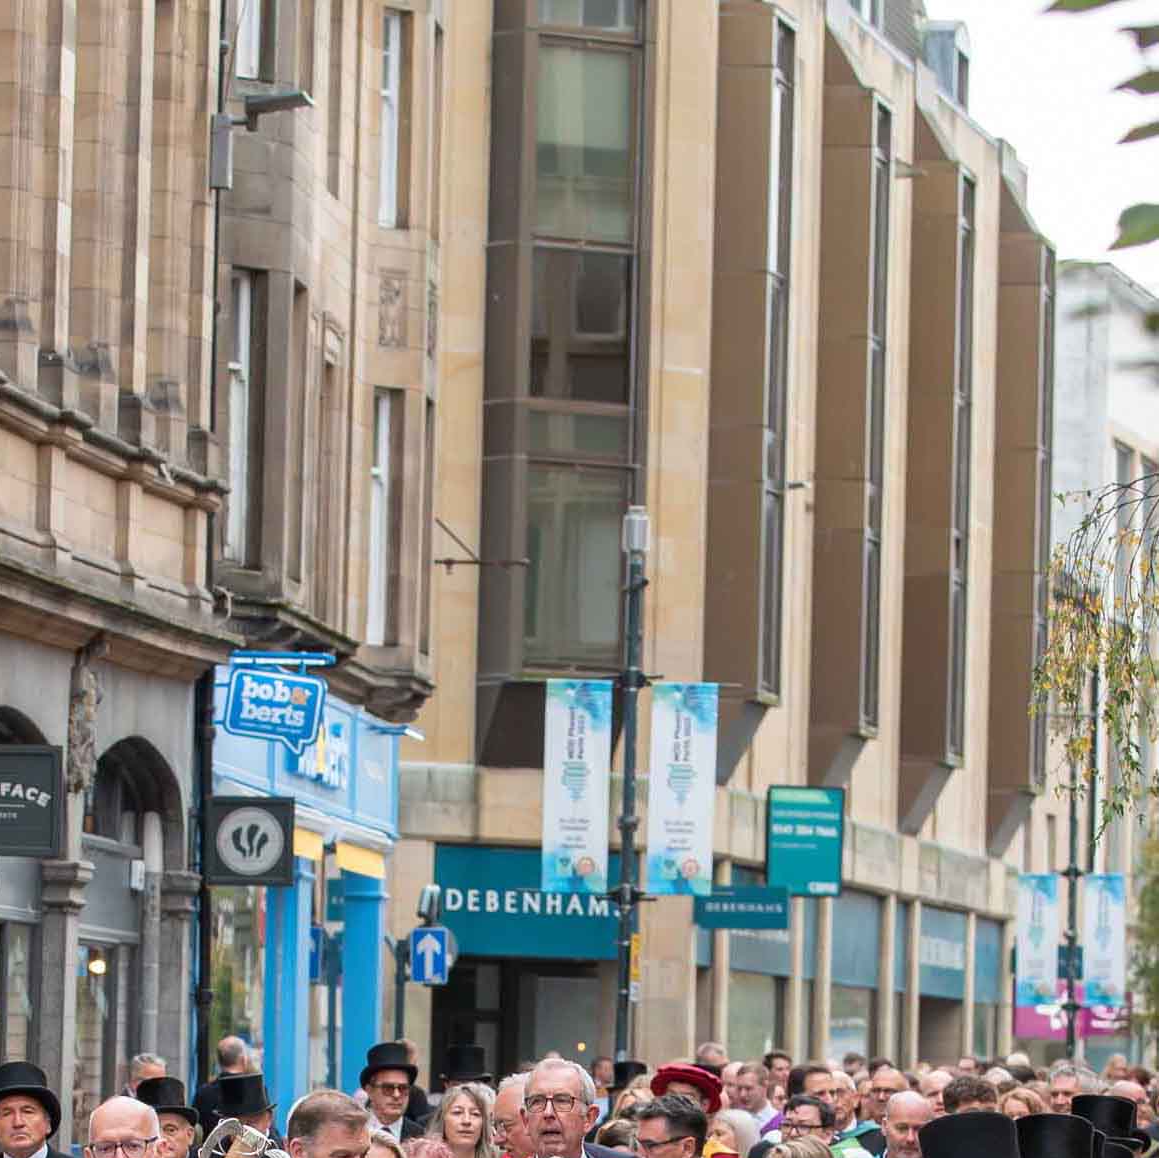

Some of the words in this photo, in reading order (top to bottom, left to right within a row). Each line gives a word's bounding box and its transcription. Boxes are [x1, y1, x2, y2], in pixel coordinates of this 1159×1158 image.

[242, 675, 291, 702] bob
[240, 699, 305, 727] berts
[445, 888, 622, 918] DEBENHAM
[704, 901, 783, 913] DEBENHAMS
